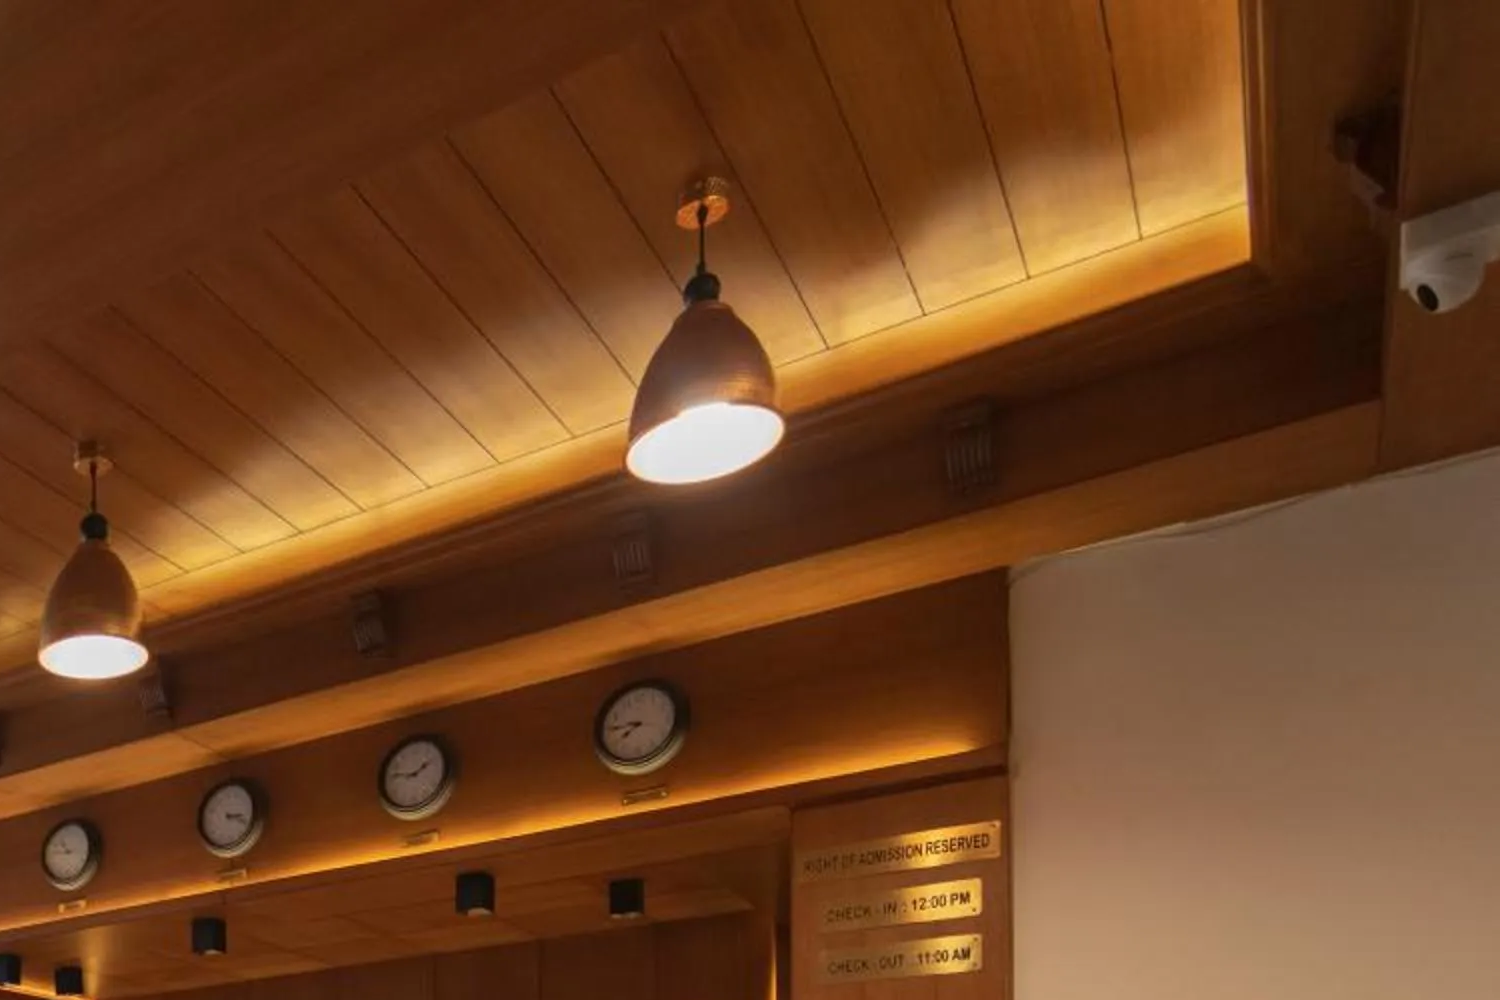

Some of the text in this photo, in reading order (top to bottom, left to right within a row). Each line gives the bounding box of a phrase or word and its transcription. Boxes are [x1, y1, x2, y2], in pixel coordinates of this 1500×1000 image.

[859, 843, 923, 866] ADMISSION
[925, 833, 990, 855] RESERVED
[826, 905, 871, 922] CHECK
[883, 901, 897, 916] IN
[912, 895, 947, 911] 12:00
[950, 891, 971, 906] PM
[827, 946, 971, 975] CHECK OUT 11:00 AM
